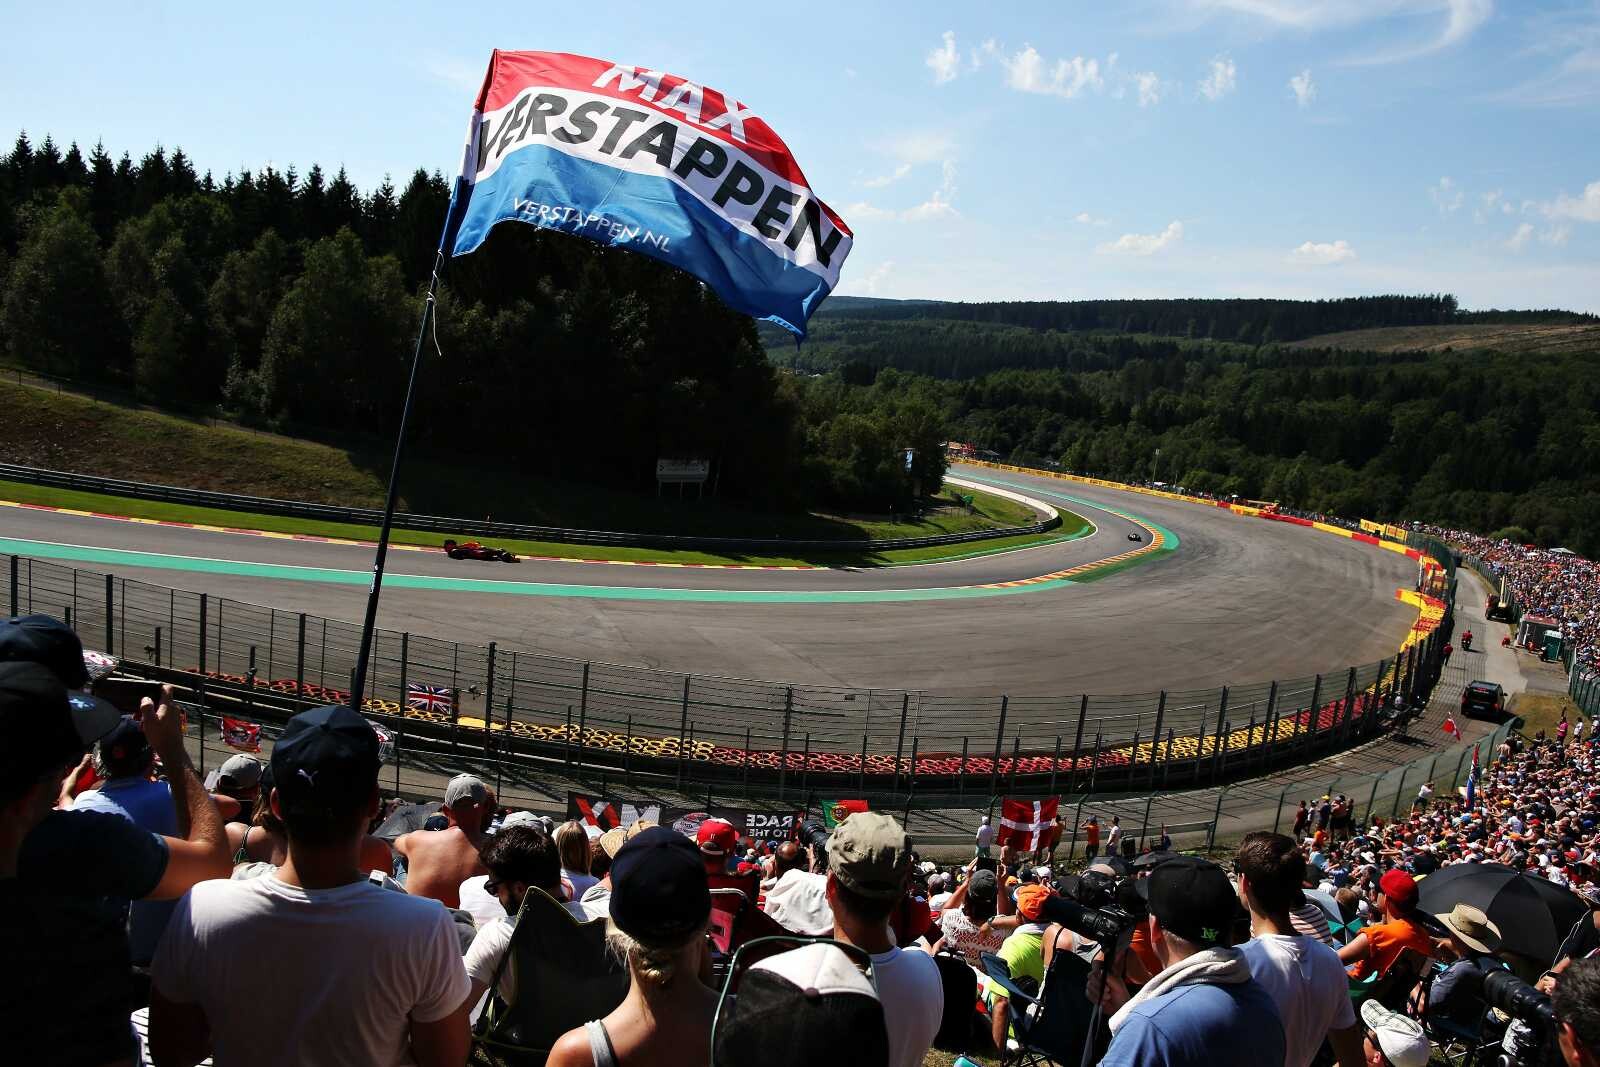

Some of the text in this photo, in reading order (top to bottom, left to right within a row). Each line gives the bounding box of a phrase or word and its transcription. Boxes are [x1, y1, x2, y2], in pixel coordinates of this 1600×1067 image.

[592, 62, 764, 143] MAX
[477, 93, 843, 268] VERSTAPPEN
[512, 197, 671, 253] VERSTAPPEN.NL
